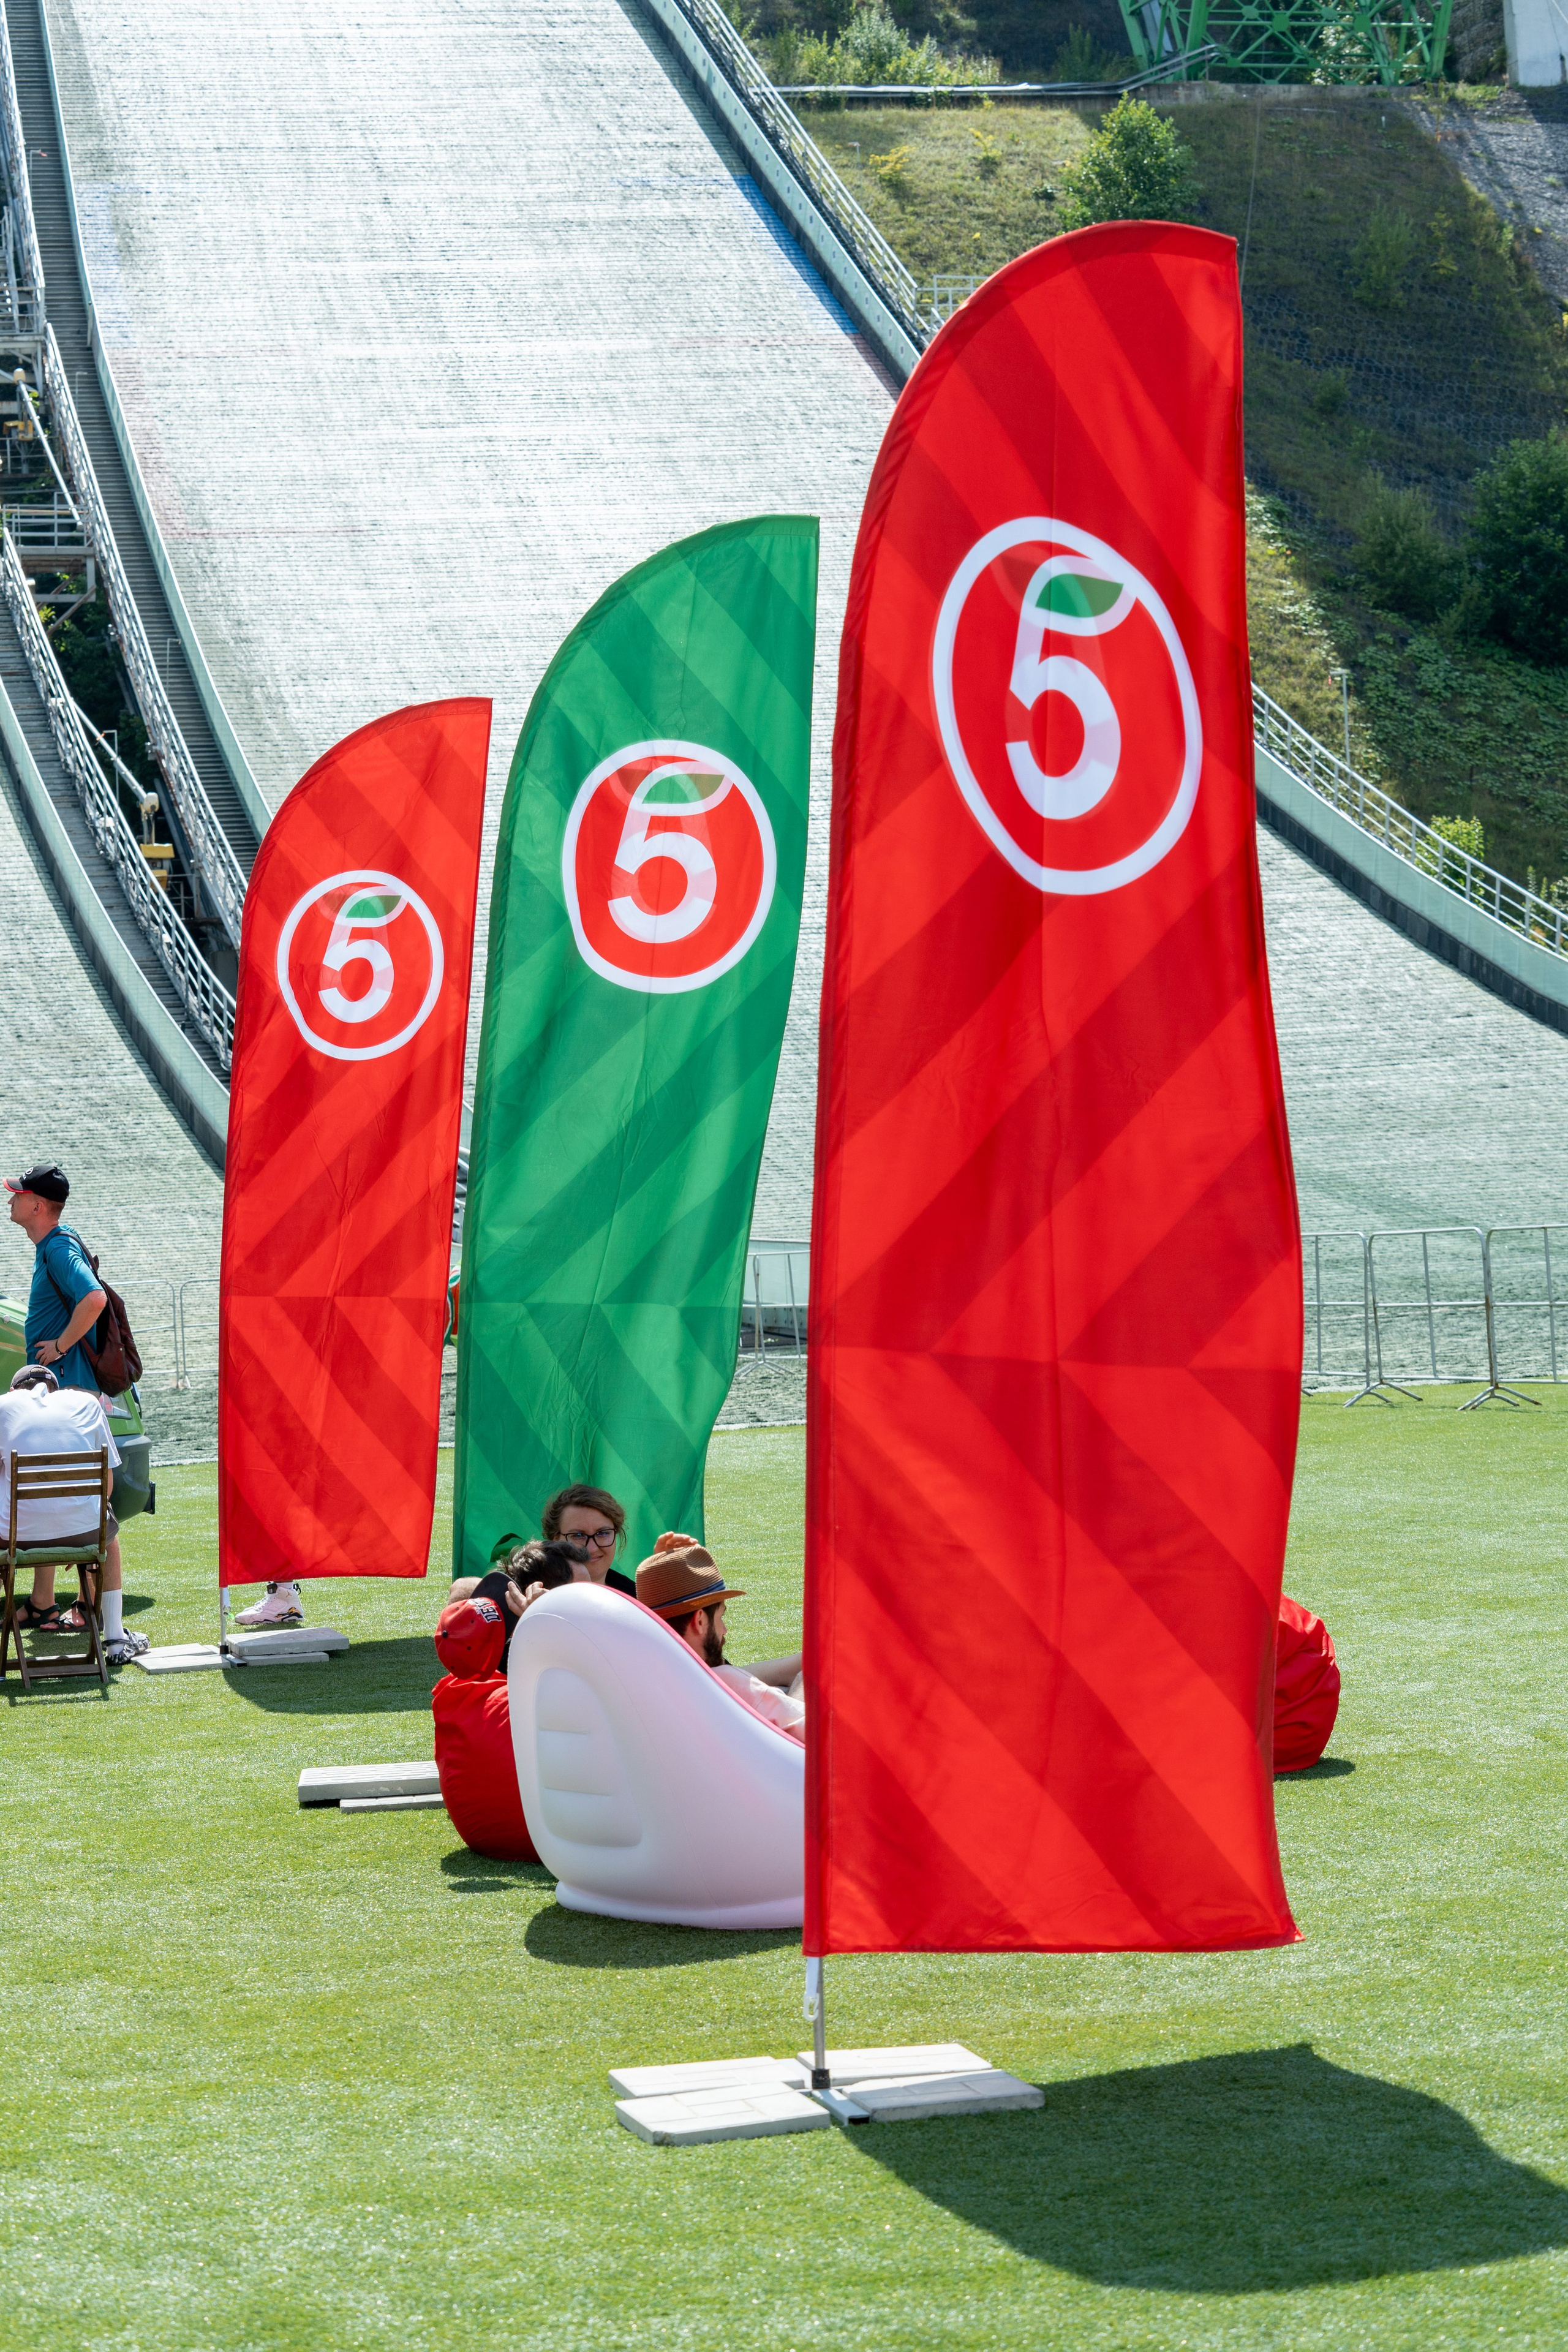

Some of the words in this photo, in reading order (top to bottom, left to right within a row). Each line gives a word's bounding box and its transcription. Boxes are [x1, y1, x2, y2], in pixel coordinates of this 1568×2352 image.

[1005, 554, 1137, 820] 5
[607, 761, 734, 944] 5
[318, 886, 409, 1023] 5
